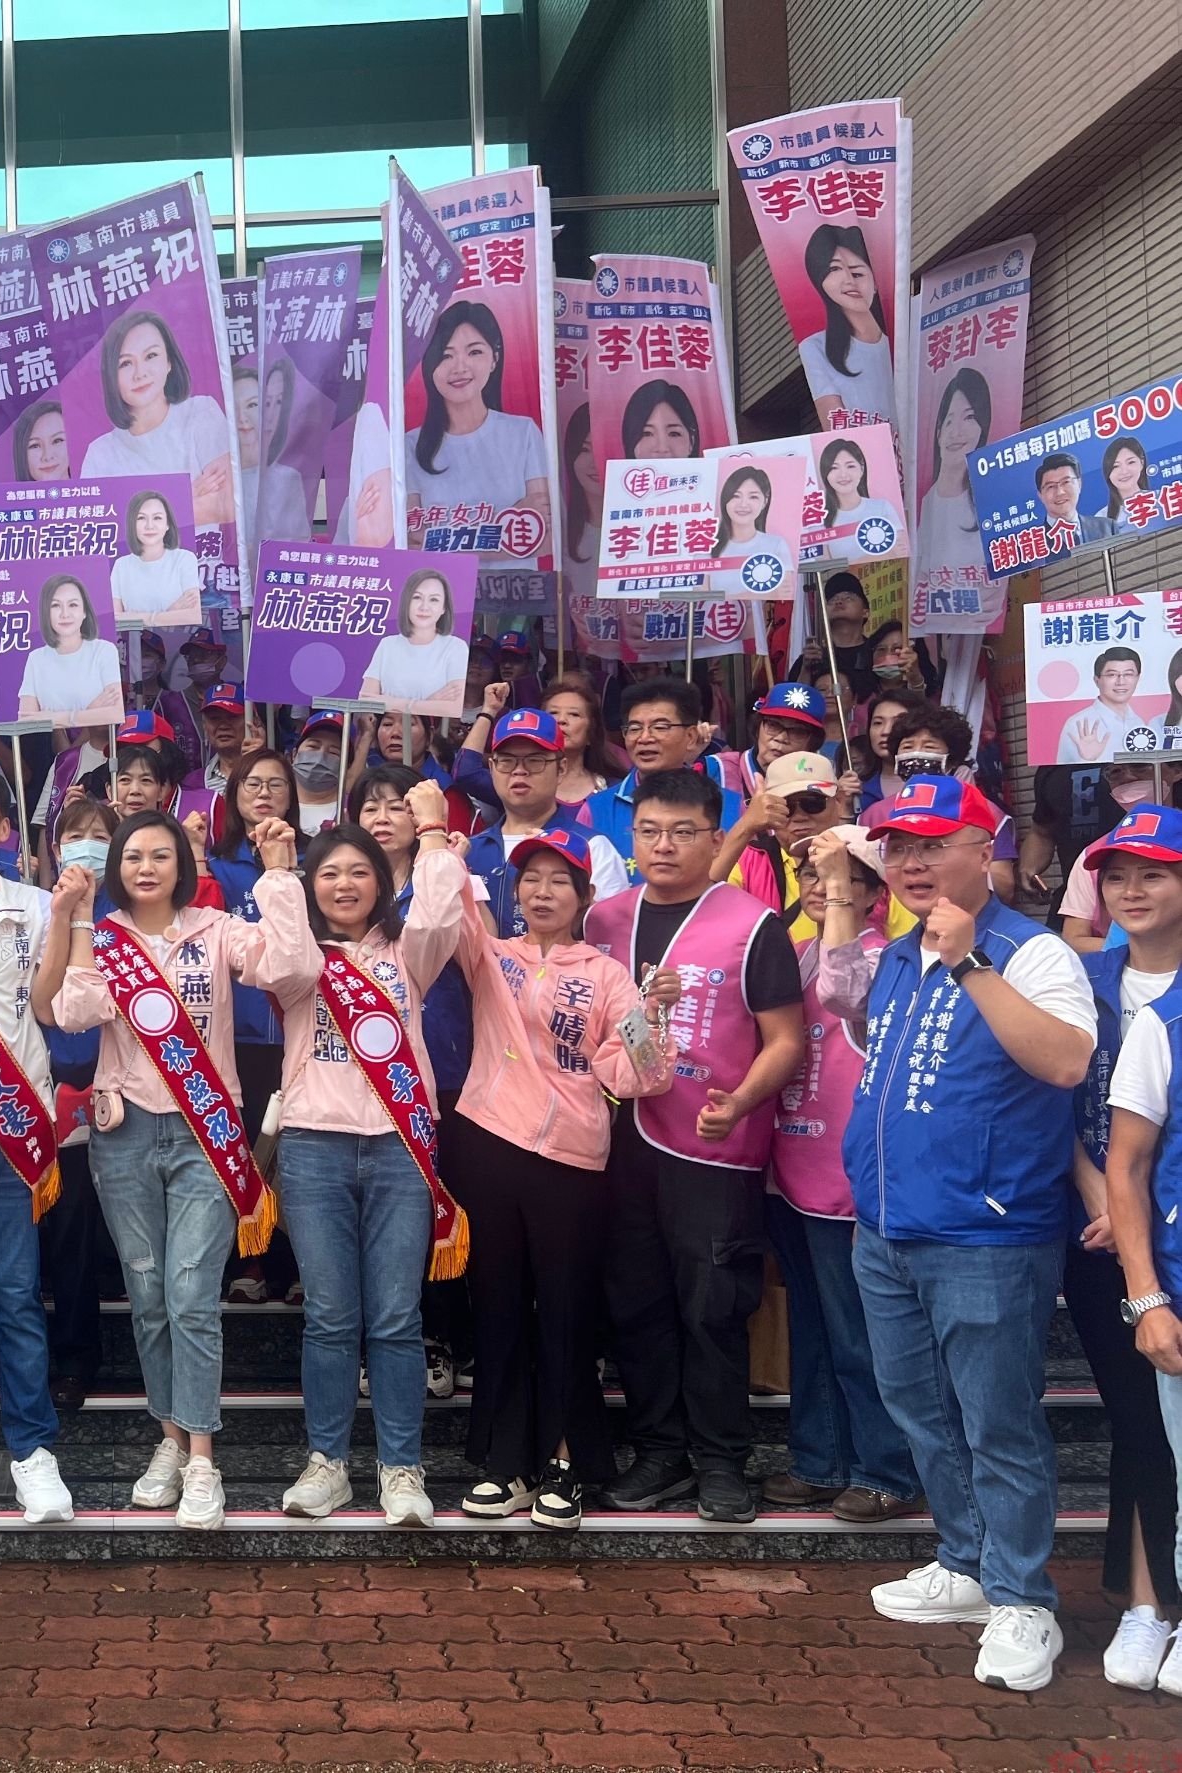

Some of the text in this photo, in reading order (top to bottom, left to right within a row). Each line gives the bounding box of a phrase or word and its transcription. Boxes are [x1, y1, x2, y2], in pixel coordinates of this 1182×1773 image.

[779, 122, 885, 150] 市議員候選人
[868, 149, 892, 162] 山上
[756, 170, 886, 222] 李佳蓉
[73, 202, 182, 255] 臺南市議員
[479, 220, 501, 234] 安定
[511, 216, 530, 229] 山上
[48, 229, 200, 322] 林燕祝
[624, 276, 703, 297] 市議員候選人
[597, 324, 713, 372] 李佳蓉
[61, 486, 101, 498] 全力以赴
[38, 503, 118, 520] 市議員候選人
[994, 511, 1039, 532] 市長候選人
[608, 517, 719, 559] 李佳蓉
[989, 517, 1078, 572] 謝龍介
[337, 554, 380, 568] 全力以赴
[265, 571, 394, 592] 永康區 市議員候選人
[257, 588, 391, 636] 林燕祝
[1045, 596, 1125, 613] 台南市市長候選人
[1042, 609, 1146, 647] 謝龍介
[328, 960, 377, 1007] 台南市
[159, 1034, 241, 1151] 林燕祝
